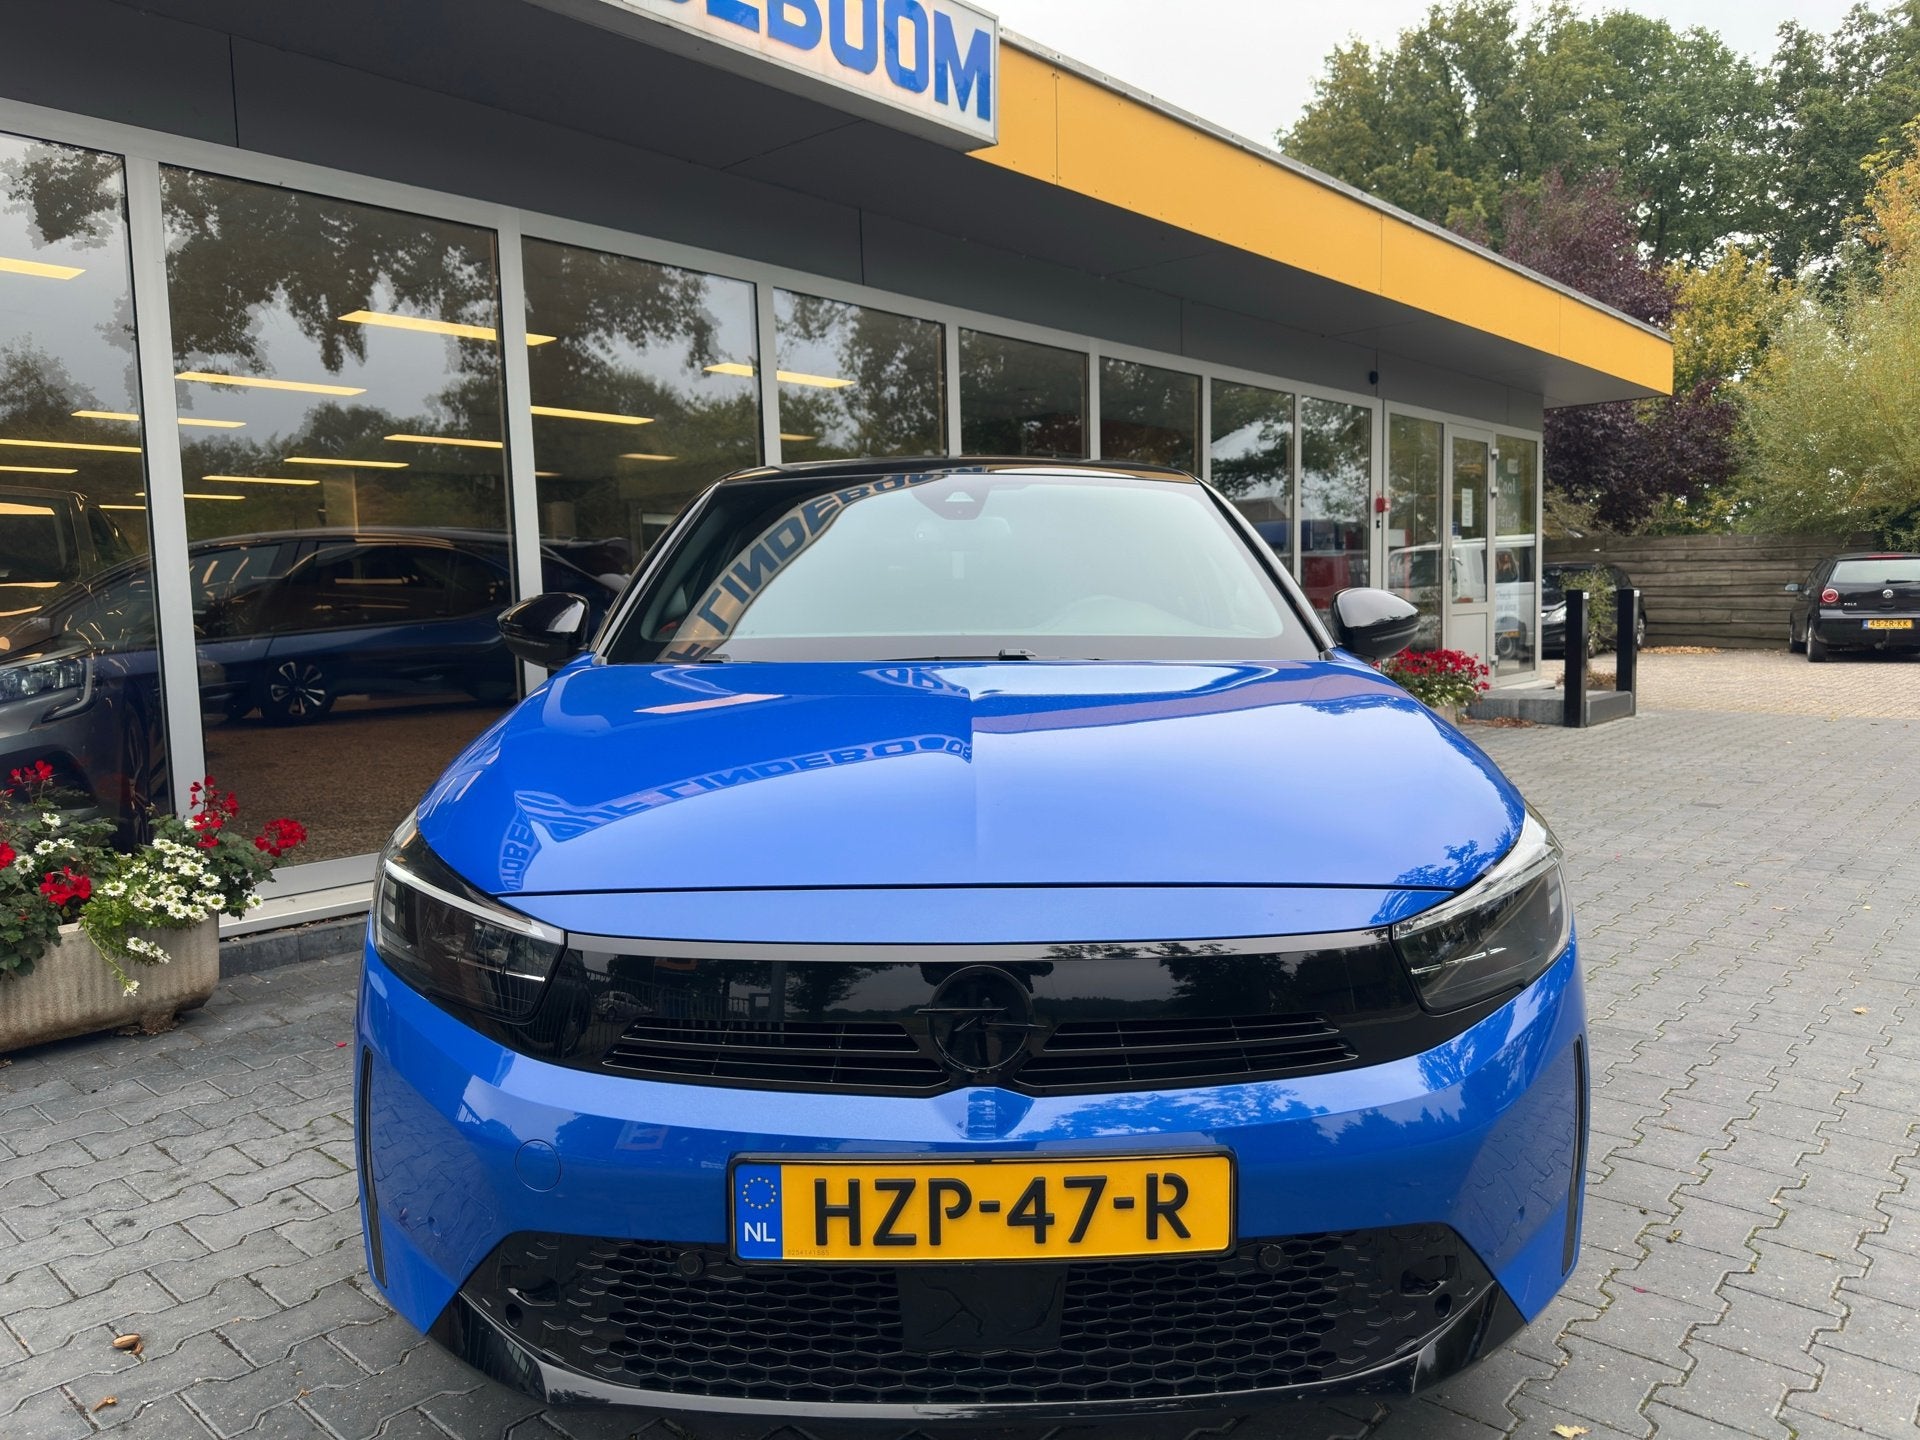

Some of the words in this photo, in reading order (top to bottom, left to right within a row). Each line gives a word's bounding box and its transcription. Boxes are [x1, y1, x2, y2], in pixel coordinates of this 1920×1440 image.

[670, 0, 991, 122] BOOM
[744, 1222, 776, 1242] NL
[814, 1173, 1192, 1246] HZP-47-R
